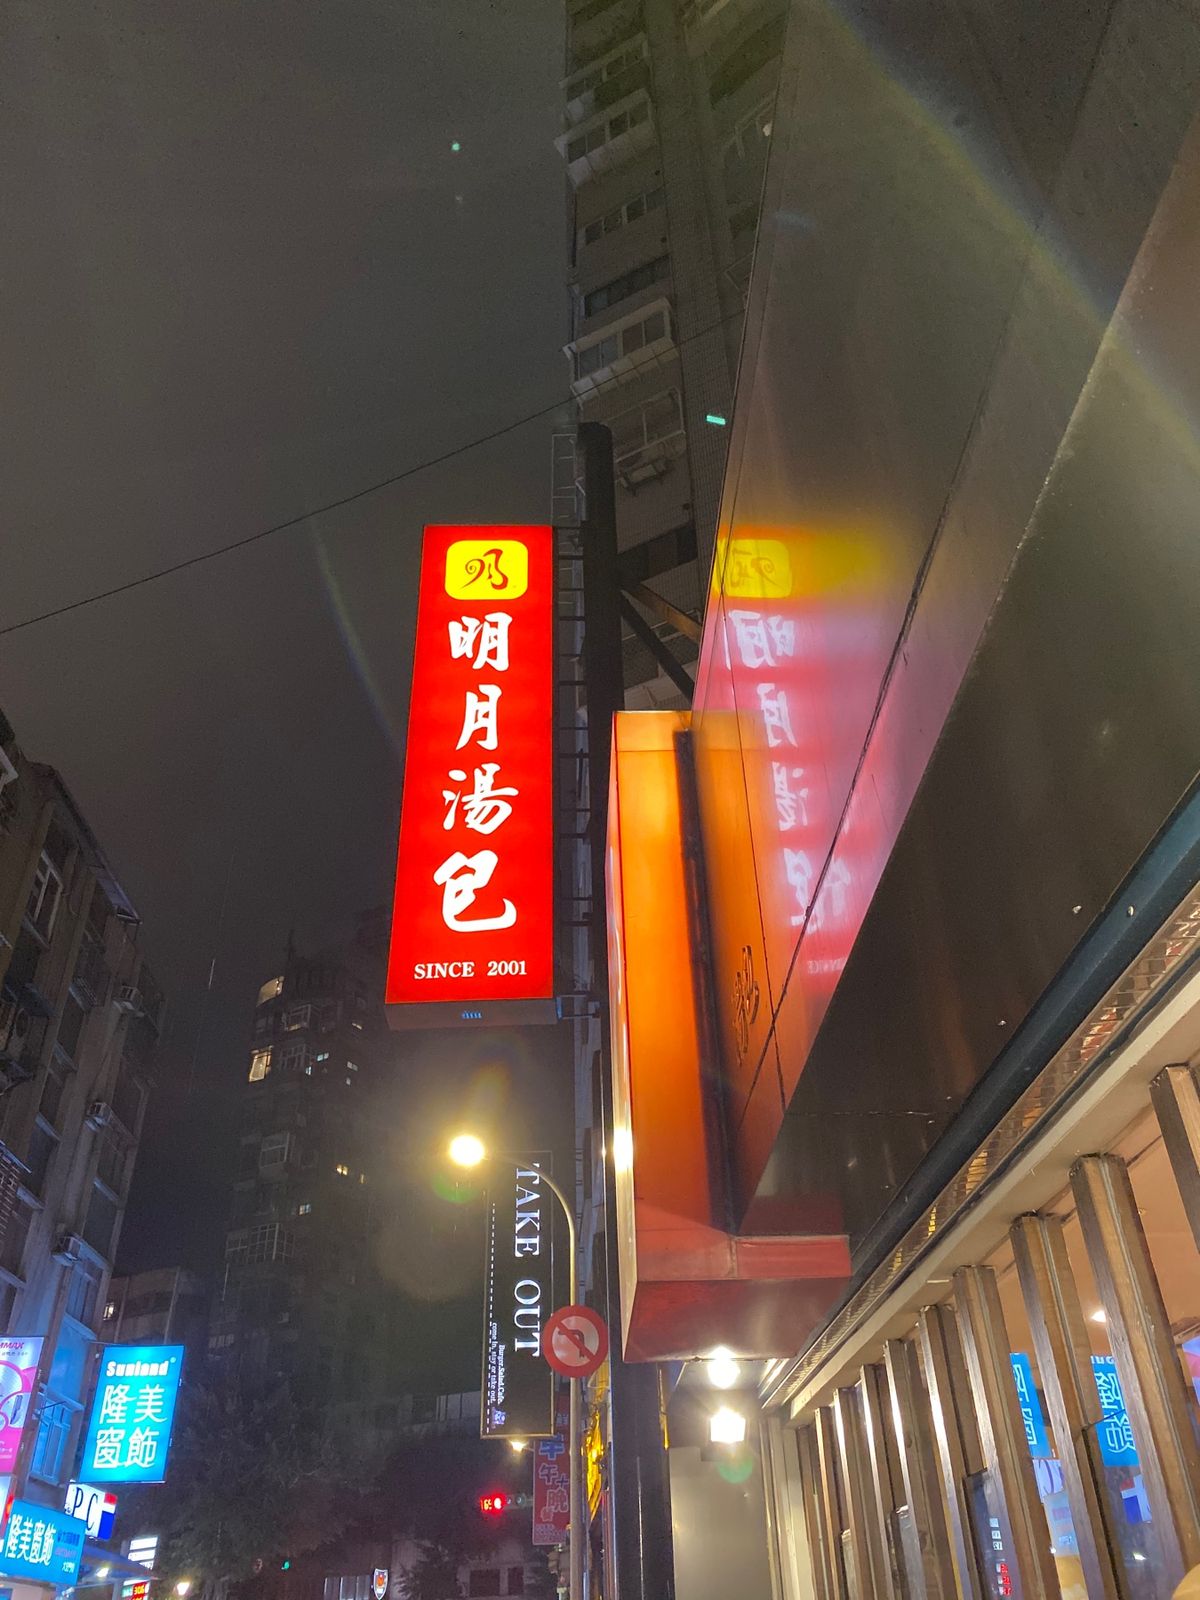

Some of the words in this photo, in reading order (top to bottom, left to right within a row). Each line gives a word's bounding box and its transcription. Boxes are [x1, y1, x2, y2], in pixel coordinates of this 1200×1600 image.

[433, 611, 519, 933] 明月湯包
[414, 962, 475, 979] SINCE
[487, 960, 527, 976] 2001
[514, 1162, 541, 1258] TAKE
[514, 1279, 542, 1358] OUT
[106, 1361, 170, 1377] Sunland
[99, 1384, 168, 1424] 隆美
[93, 1426, 159, 1468] 窗飾
[4, 1513, 57, 1567] 隆美窗飾
